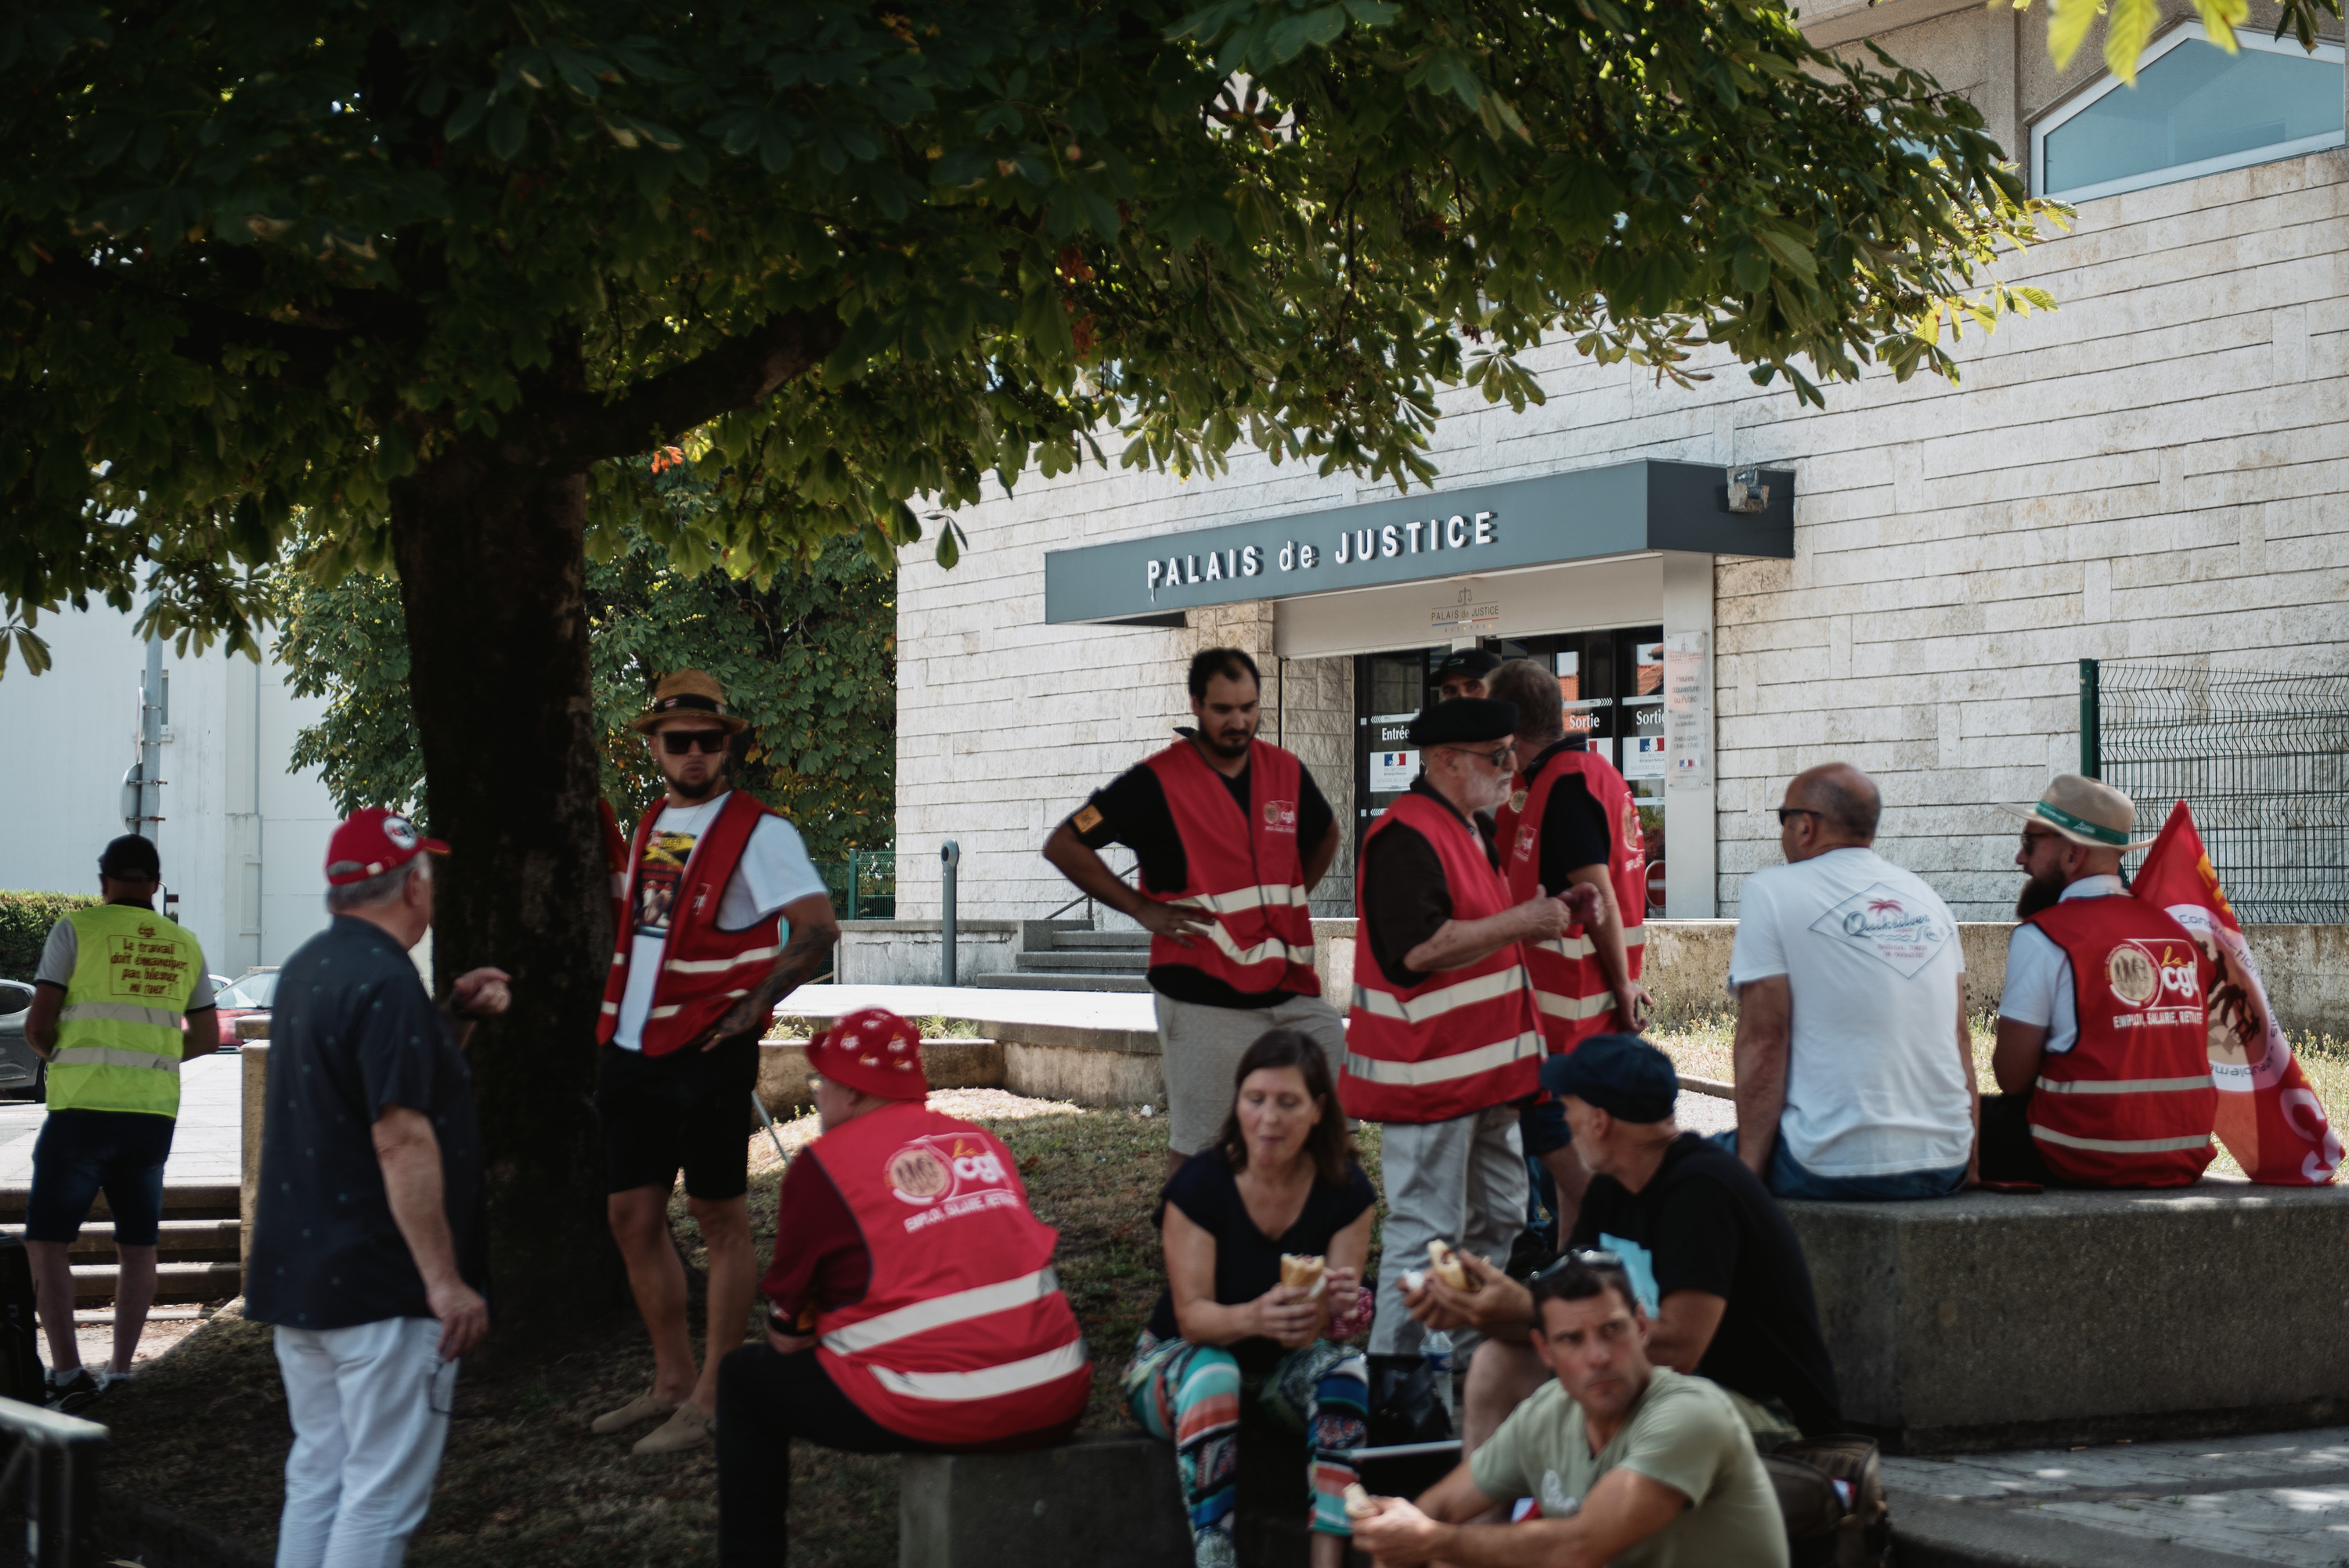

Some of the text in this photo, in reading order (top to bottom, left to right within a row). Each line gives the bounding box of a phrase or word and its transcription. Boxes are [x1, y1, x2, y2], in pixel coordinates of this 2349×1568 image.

[1147, 511, 1493, 589] PALAIS de JUSTICE
[1431, 605, 1499, 621] PALAIS de JUSTICE
[1681, 694, 1697, 703] Public
[1569, 712, 1600, 728] Sortie
[1381, 725, 1410, 741] Entrée
[1843, 911, 1930, 939] Quiksilver
[123, 938, 175, 955] Le travail
[110, 952, 132, 964] doit
[2161, 946, 2189, 968] la
[121, 968, 141, 981] pas
[2162, 961, 2199, 997] cgt
[953, 1150, 1006, 1184] cgt
